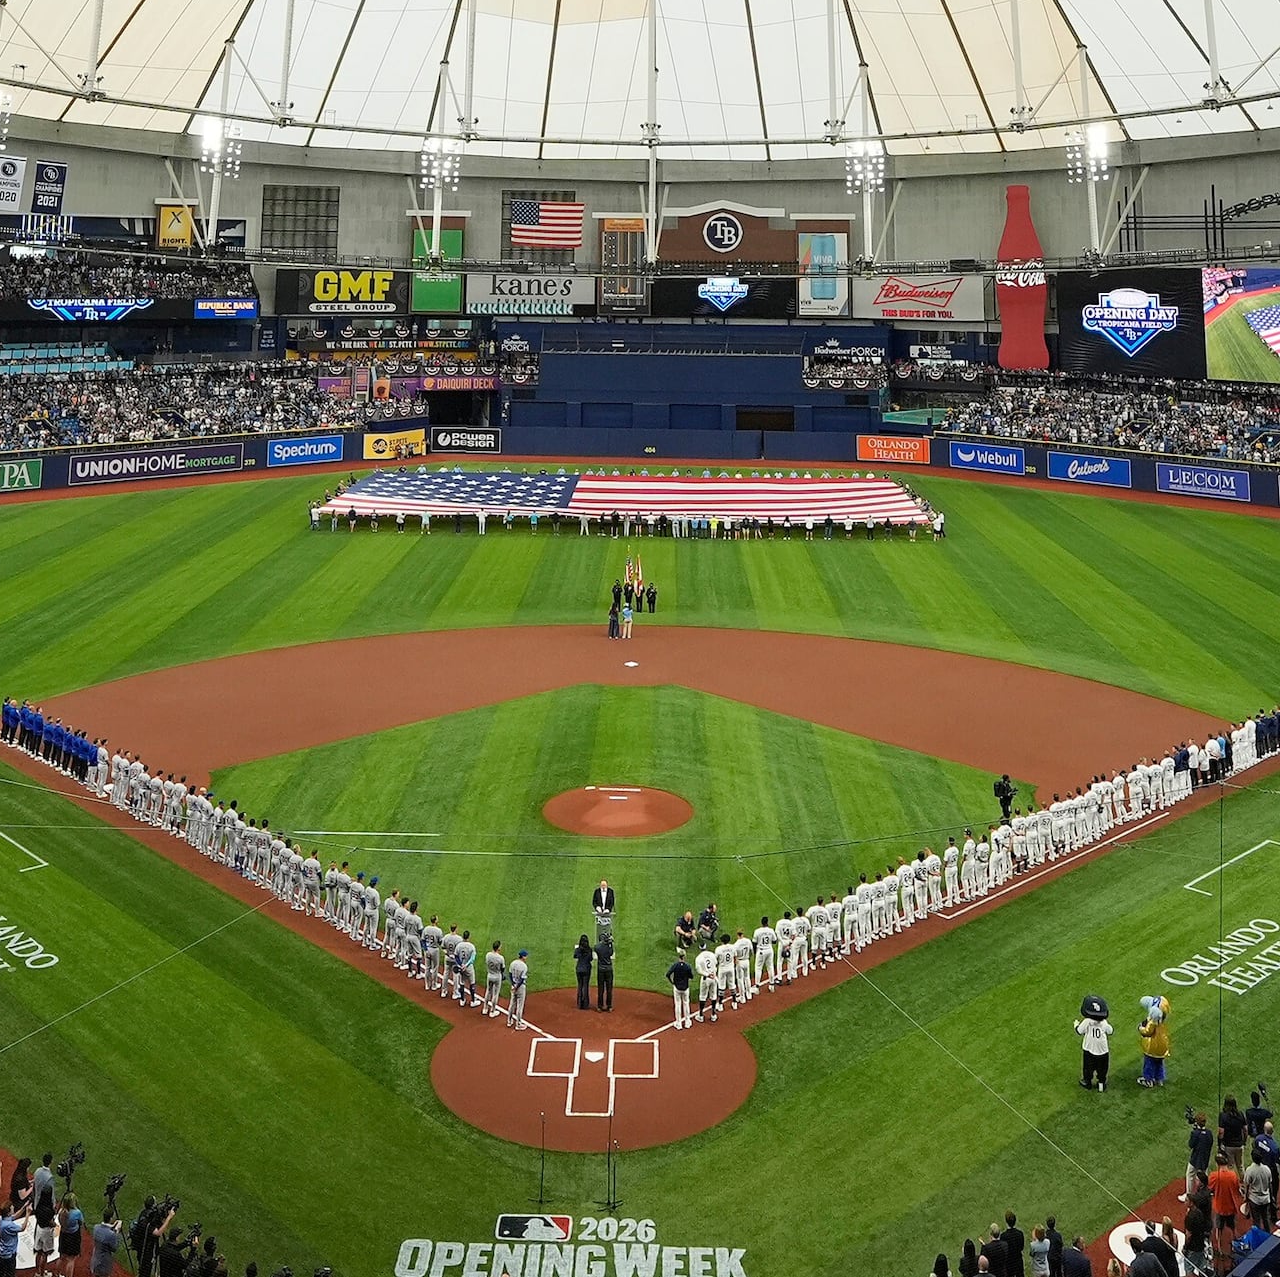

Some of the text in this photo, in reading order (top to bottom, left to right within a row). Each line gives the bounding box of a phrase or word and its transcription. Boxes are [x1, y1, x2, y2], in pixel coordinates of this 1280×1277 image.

[37, 195, 58, 207] 2021
[711, 221, 736, 245] TB
[813, 255, 833, 264] VIVA
[314, 271, 393, 302] GMF
[881, 284, 954, 299] Budweiser
[47, 299, 107, 307] TROPICANA
[197, 302, 255, 310] REPUBLIC BANK
[882, 309, 954, 318] THIS BUD'S FOR YOU.
[1085, 307, 1176, 321] OPENING DAY
[1098, 320, 1141, 328] TROPICANA
[501, 344, 529, 352] PORCH
[851, 347, 885, 357] PORCH
[437, 378, 494, 389] DAIQUIRI DECK
[867, 438, 920, 450] ORLANDO
[274, 442, 332, 459] Spectrum
[874, 449, 914, 460] HEALTH
[977, 450, 1017, 467] Webull
[1067, 459, 1110, 479] Culver's
[816, 915, 824, 924] 15
[725, 953, 731, 962] 8
[1160, 918, 1280, 986] ORLANDO
[705, 959, 712, 969] 2
[1092, 1028, 1100, 1038] 10
[578, 1216, 656, 1243] 2026
[393, 1238, 749, 1277] OPENING WEEK
